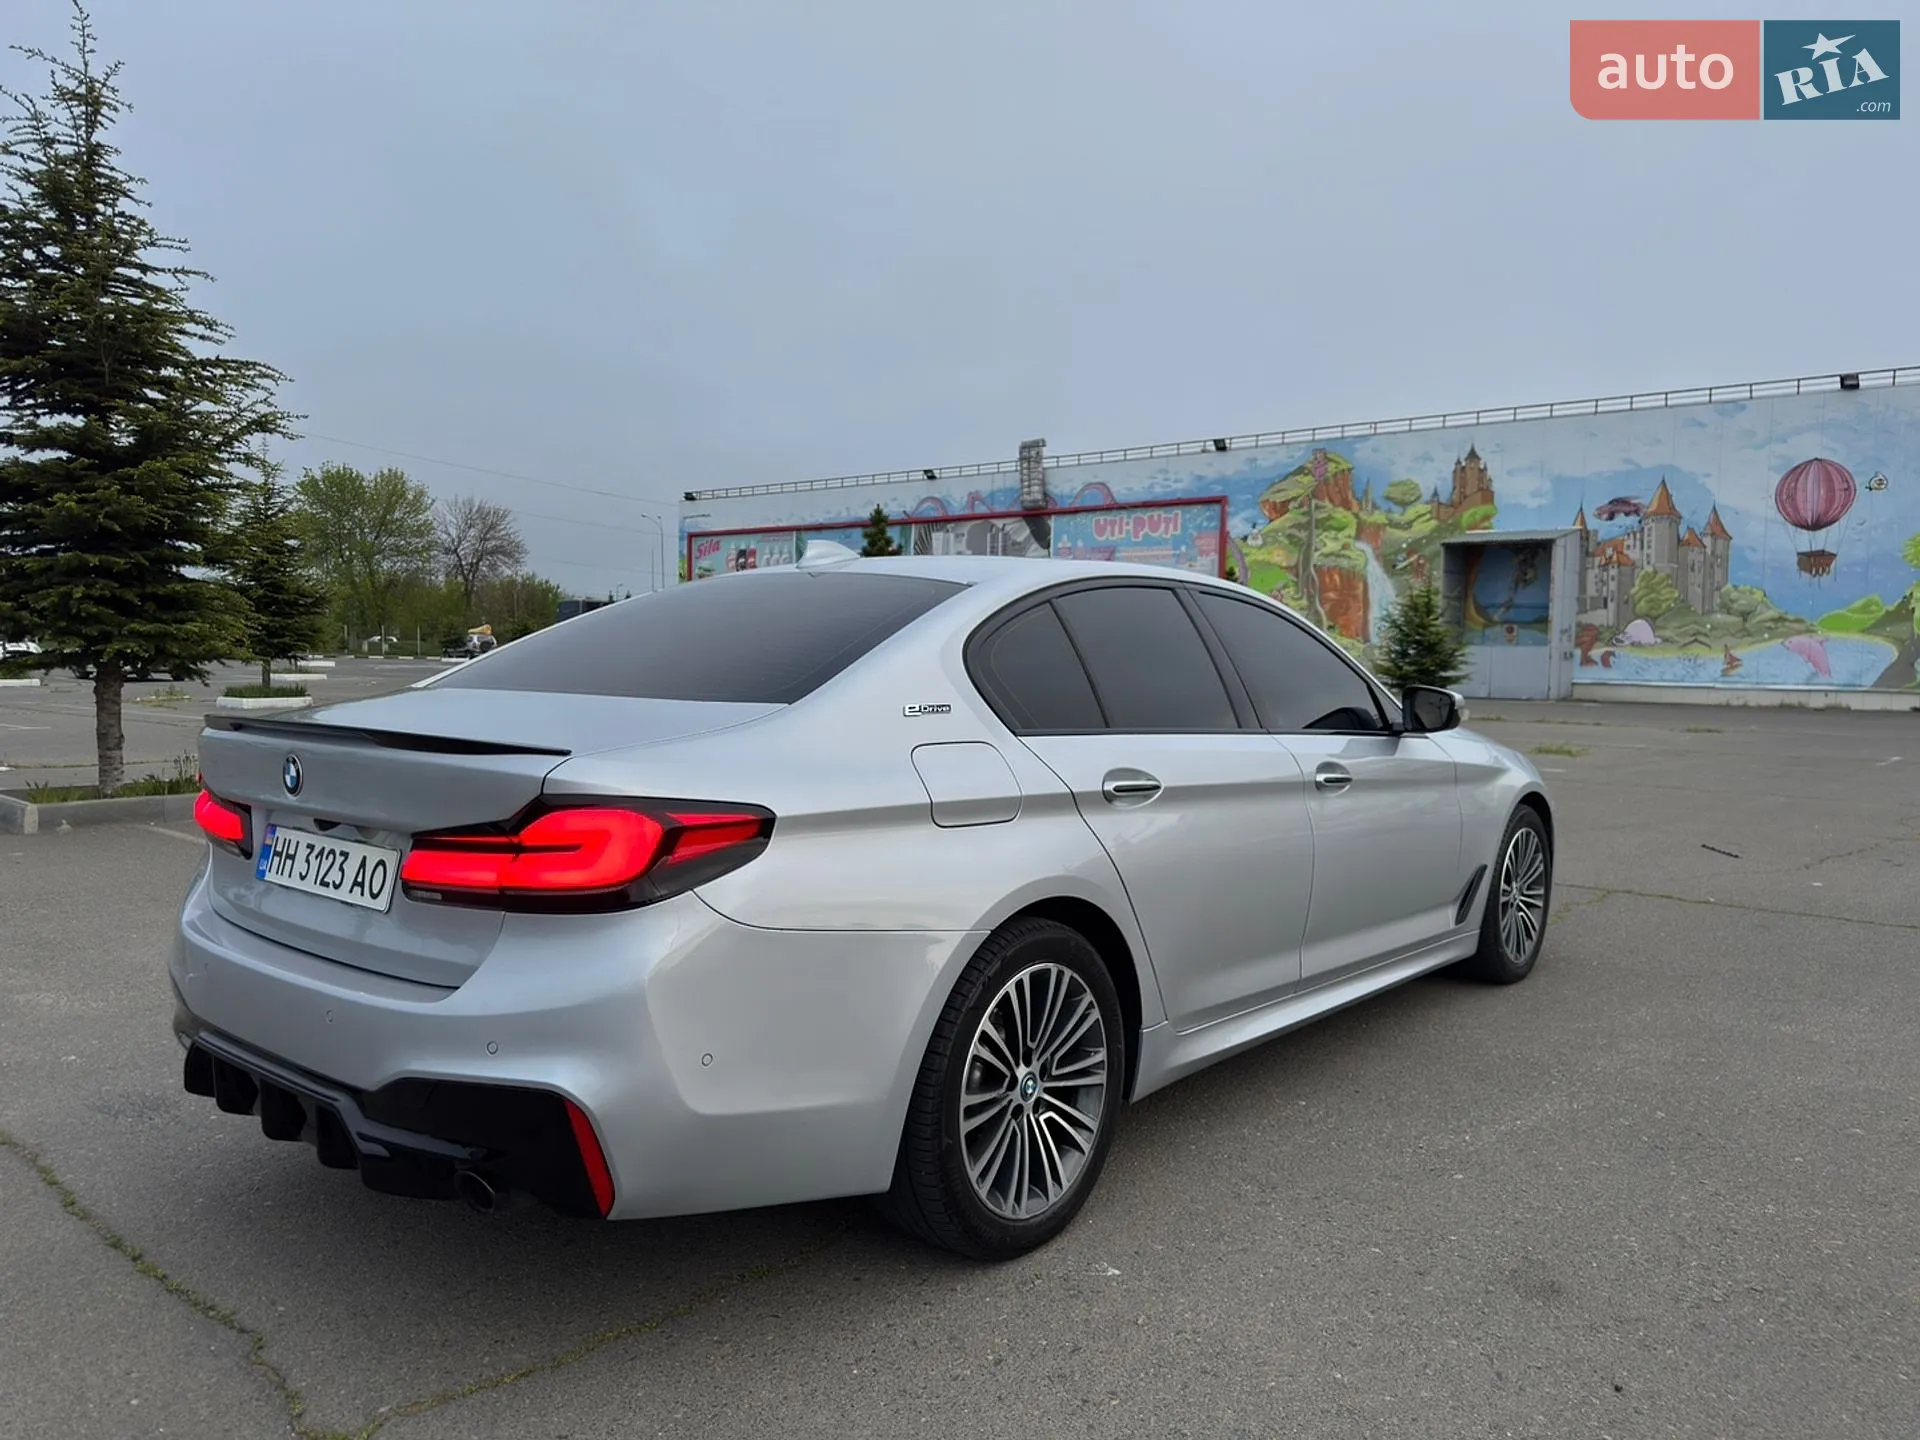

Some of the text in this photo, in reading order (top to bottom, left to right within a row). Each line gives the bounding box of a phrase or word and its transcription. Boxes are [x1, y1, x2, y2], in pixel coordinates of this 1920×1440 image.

[268, 836, 388, 900] HH 3123 AO
